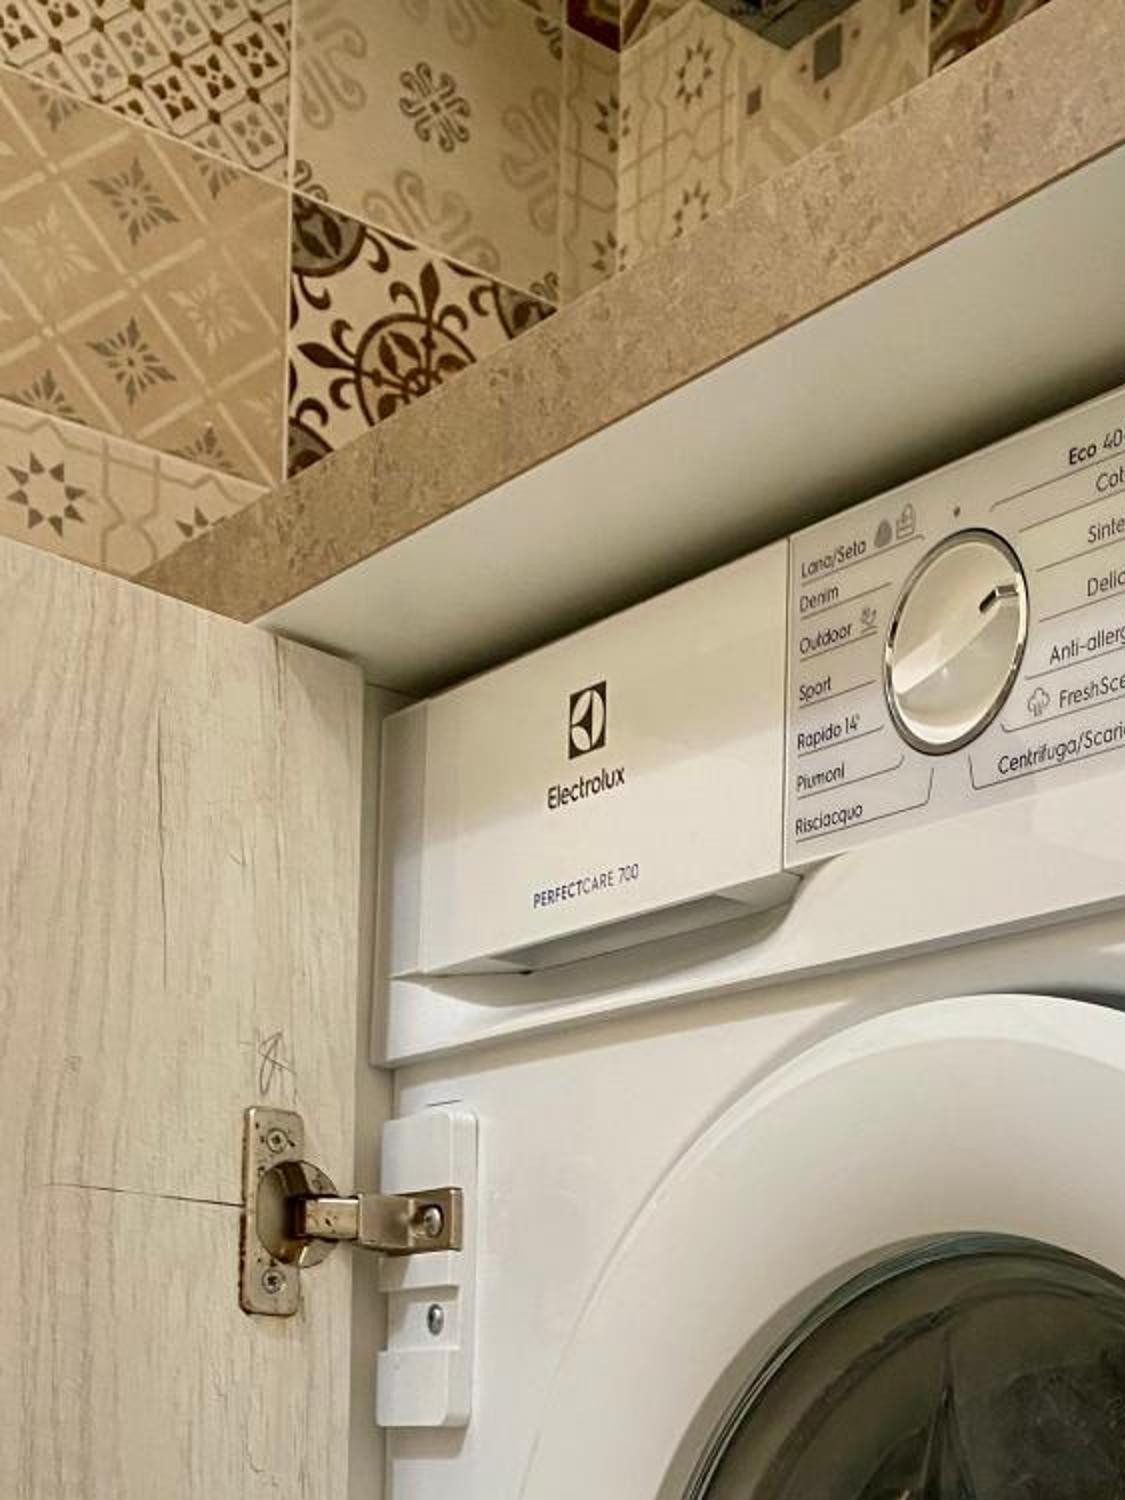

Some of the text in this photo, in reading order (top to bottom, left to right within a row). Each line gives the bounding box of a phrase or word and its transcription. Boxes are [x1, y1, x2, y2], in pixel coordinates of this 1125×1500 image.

[1068, 442, 1098, 466] Eco
[800, 540, 867, 578] Lana/Seta
[799, 585, 840, 612] Denim
[799, 623, 853, 655] Outdoor
[799, 675, 832, 702] Sport
[796, 723, 842, 751] Rapido
[547, 767, 626, 810] Electrolux
[796, 761, 846, 792] Piumoni
[533, 863, 640, 908] PERFECTCARE 700
